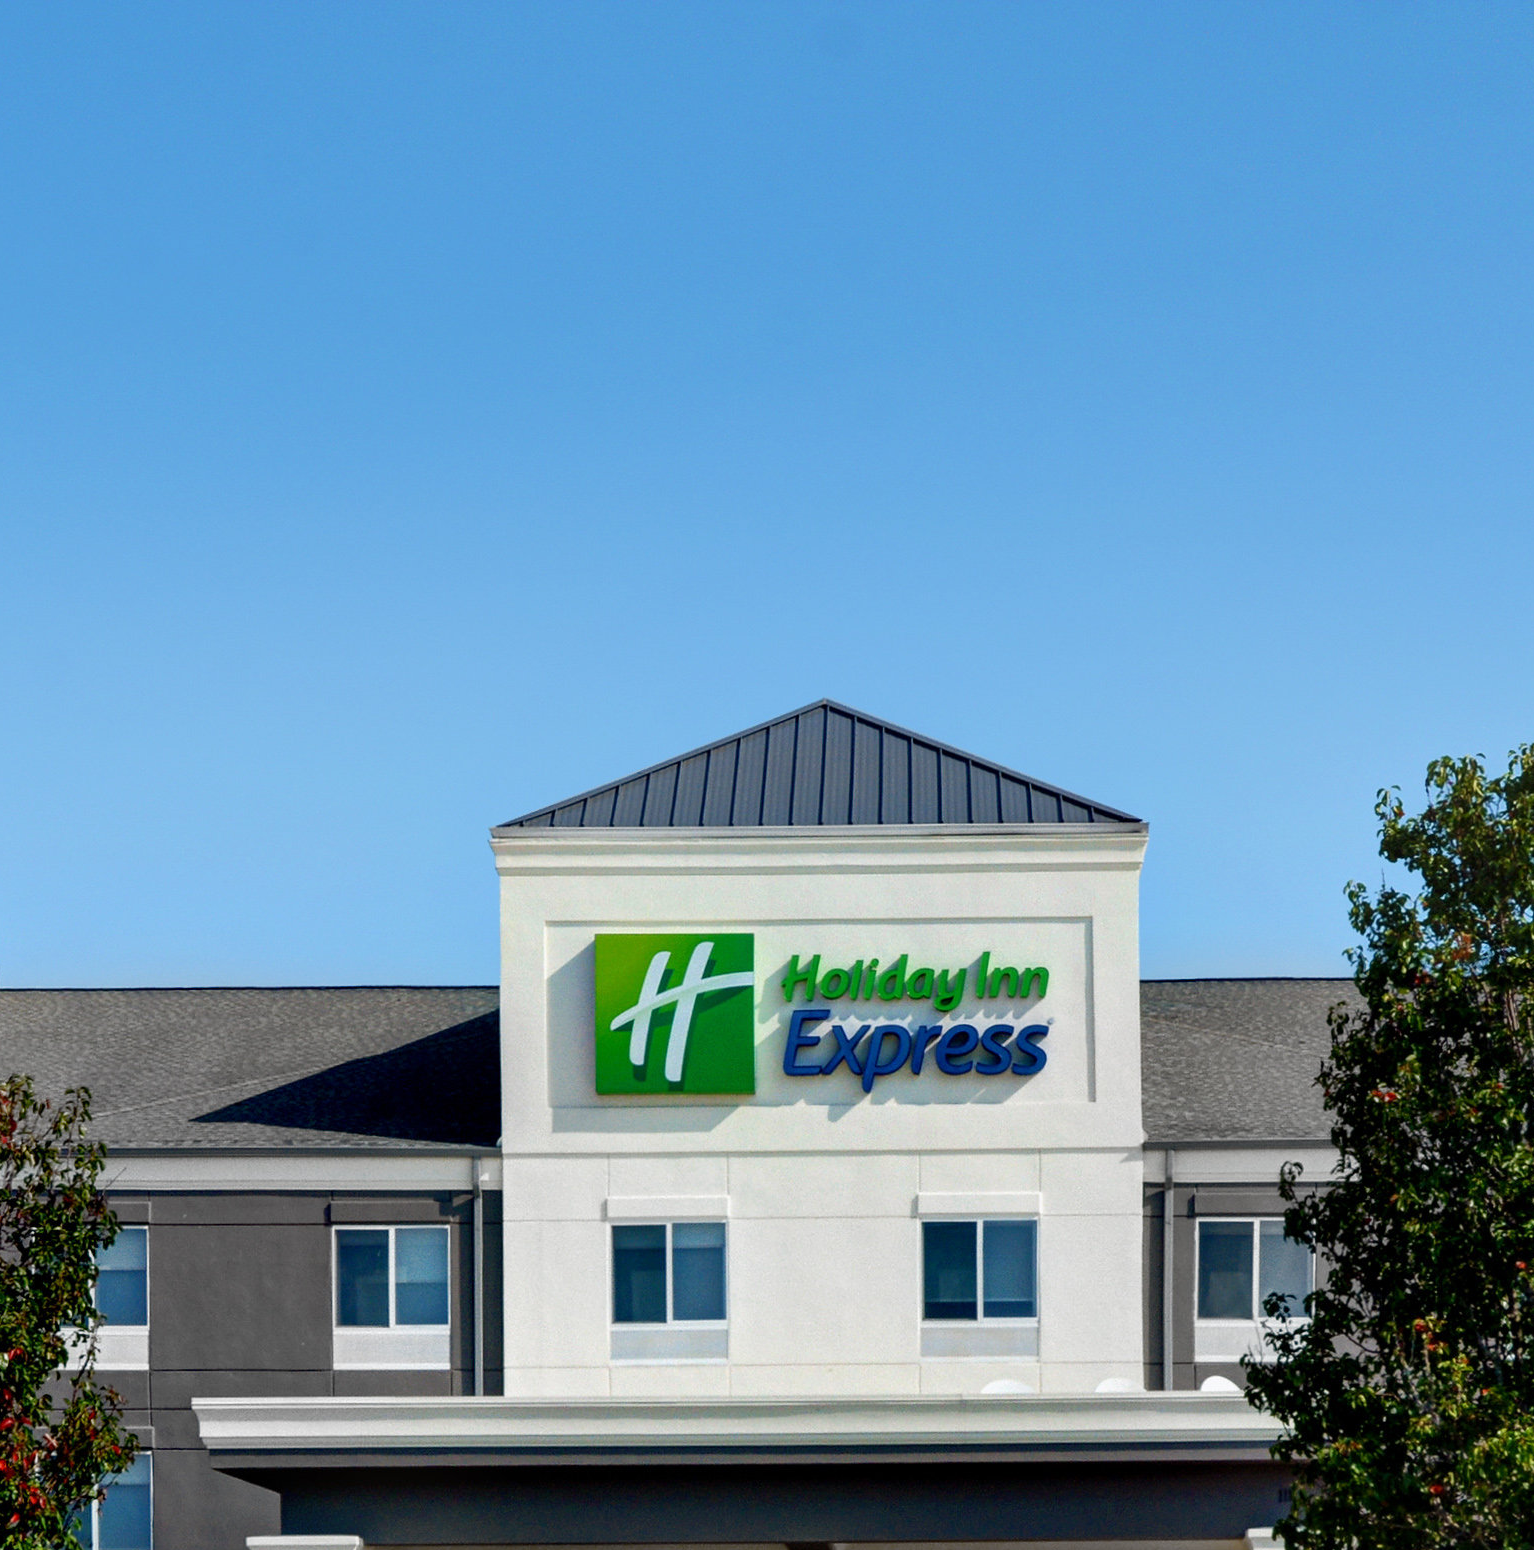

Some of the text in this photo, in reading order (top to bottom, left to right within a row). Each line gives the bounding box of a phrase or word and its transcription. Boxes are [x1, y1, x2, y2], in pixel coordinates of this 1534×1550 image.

[781, 951, 1050, 1012] Holiday Inn
[783, 1009, 1050, 1094] Express
